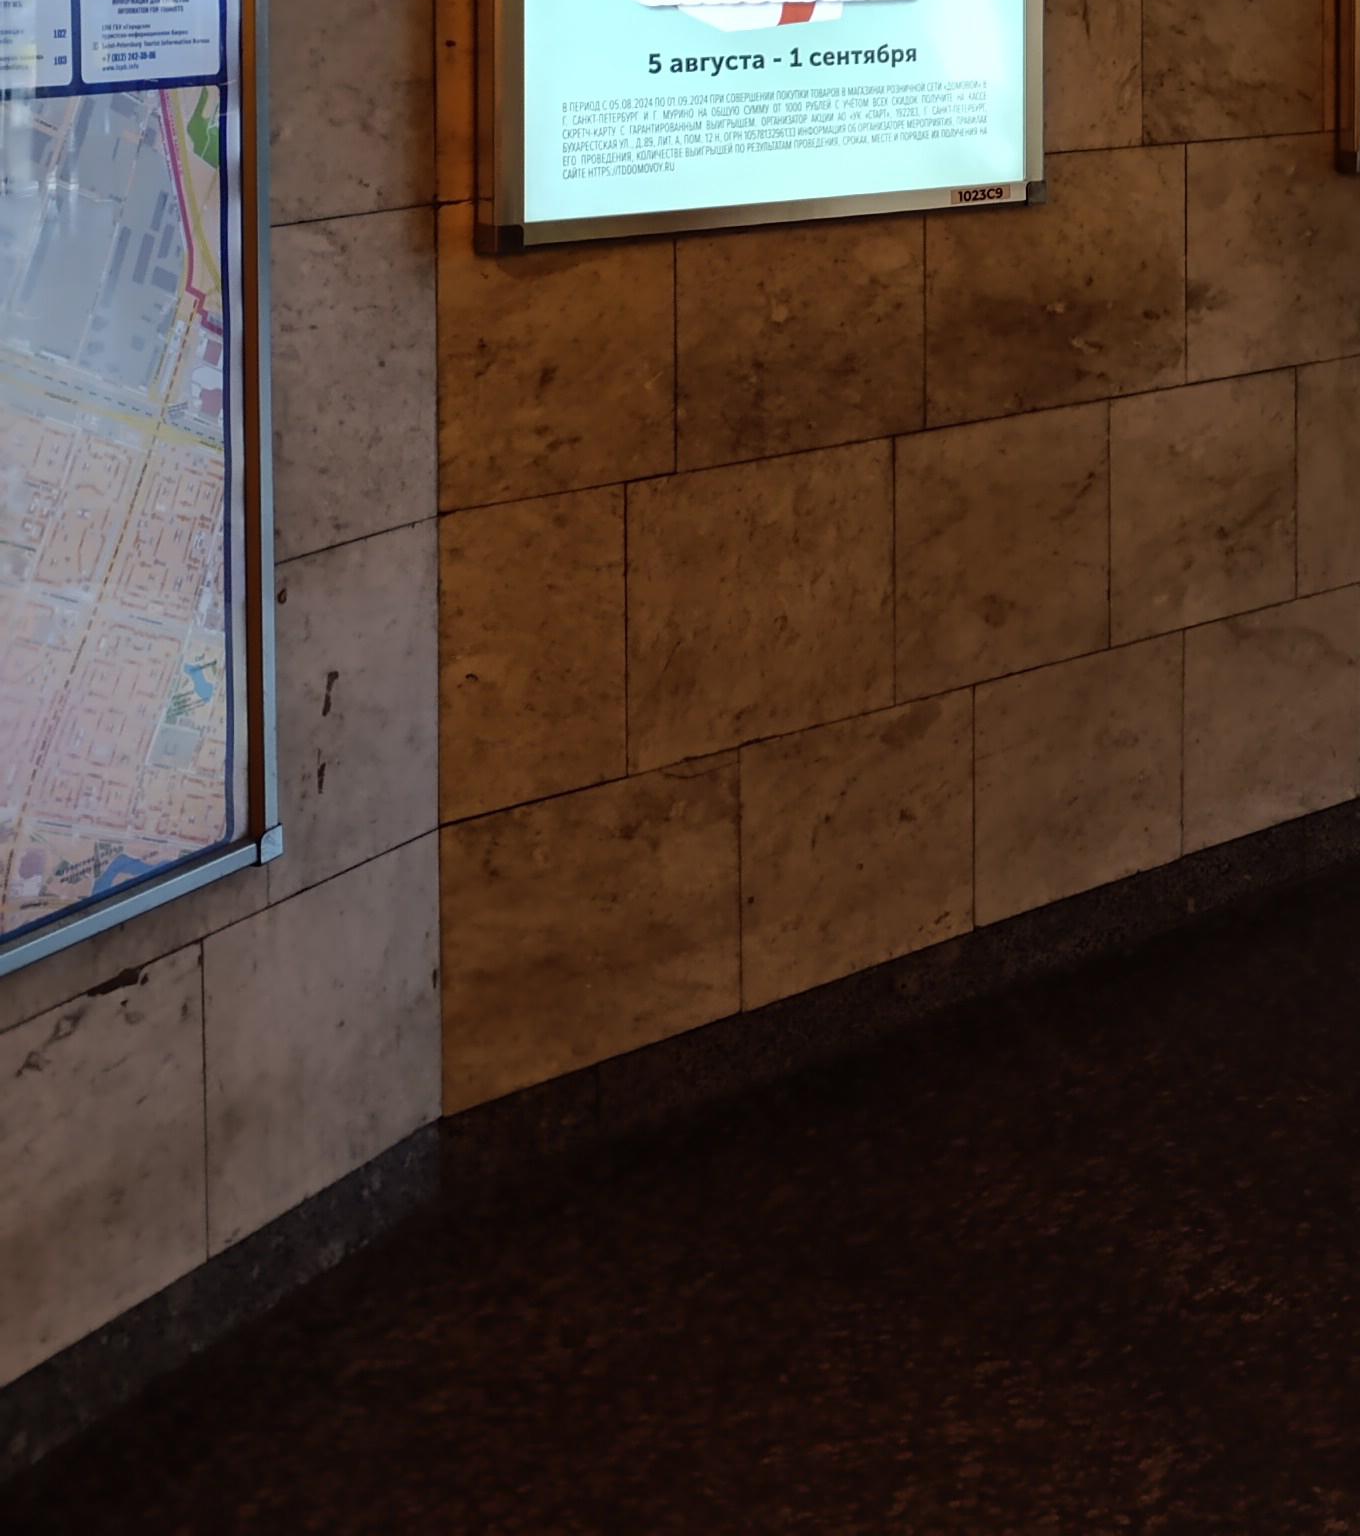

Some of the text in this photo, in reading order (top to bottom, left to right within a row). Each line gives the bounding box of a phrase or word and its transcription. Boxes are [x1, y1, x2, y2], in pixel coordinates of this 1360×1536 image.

[648, 53, 662, 75] 5
[670, 51, 766, 79] августа
[790, 48, 801, 68] 1
[809, 44, 917, 71] сентября
[569, 100, 600, 113] ПЕРИОД
[608, 97, 652, 110] 05.08.2024
[654, 97, 664, 108] ПО
[666, 94, 707, 107] 01.09.2024
[709, 93, 723, 105] ПРИ
[662, 107, 694, 120] МУРИНО
[697, 106, 707, 117] НА
[710, 104, 739, 117] ОБЩУЮ
[743, 102, 769, 115] СУММУ
[629, 120, 701, 136] ГАРАНТИРОВАННЫМ
[562, 155, 576, 167] ЕГО
[636, 147, 683, 161] КОЛИЧЕСТВЕ
[734, 142, 745, 154] ПО
[562, 168, 585, 180] САЙТЕ
[958, 188, 1003, 202] 1023C9
